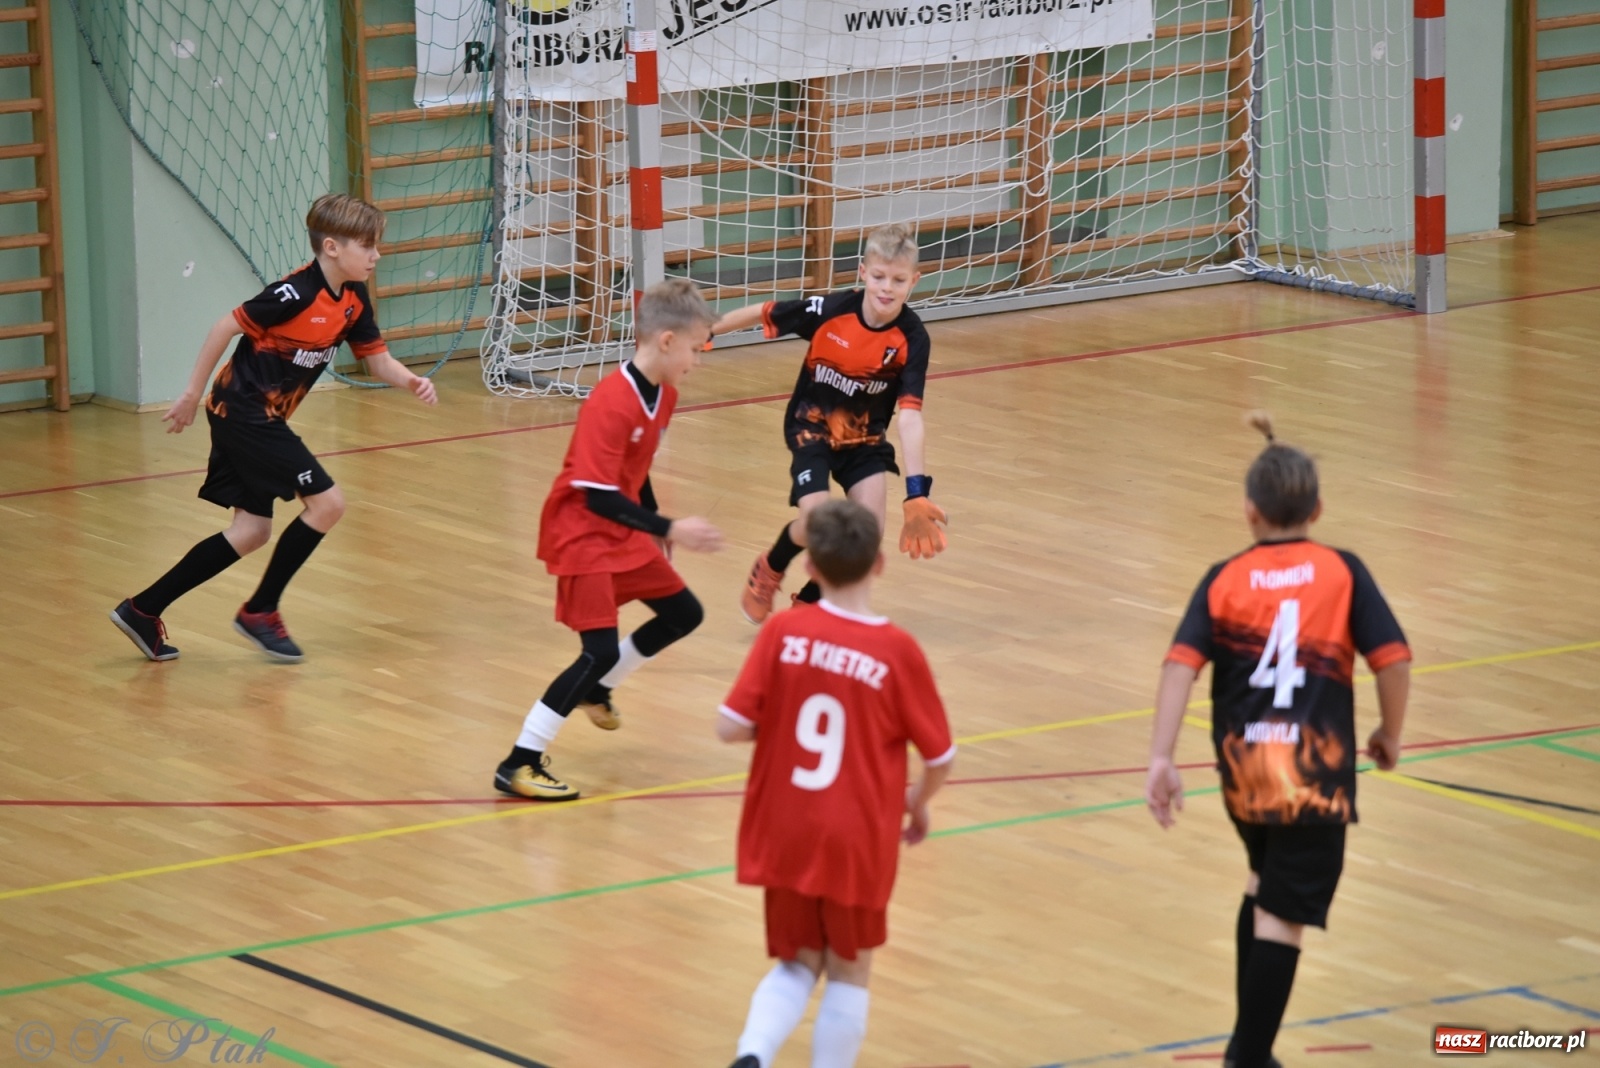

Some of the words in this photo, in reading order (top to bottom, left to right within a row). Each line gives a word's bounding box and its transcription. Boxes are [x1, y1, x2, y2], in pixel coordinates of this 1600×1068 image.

[779, 635, 810, 665] ZS
[809, 640, 889, 690] KIETRZ
[1248, 598, 1306, 709] 4
[791, 693, 846, 791] 9
